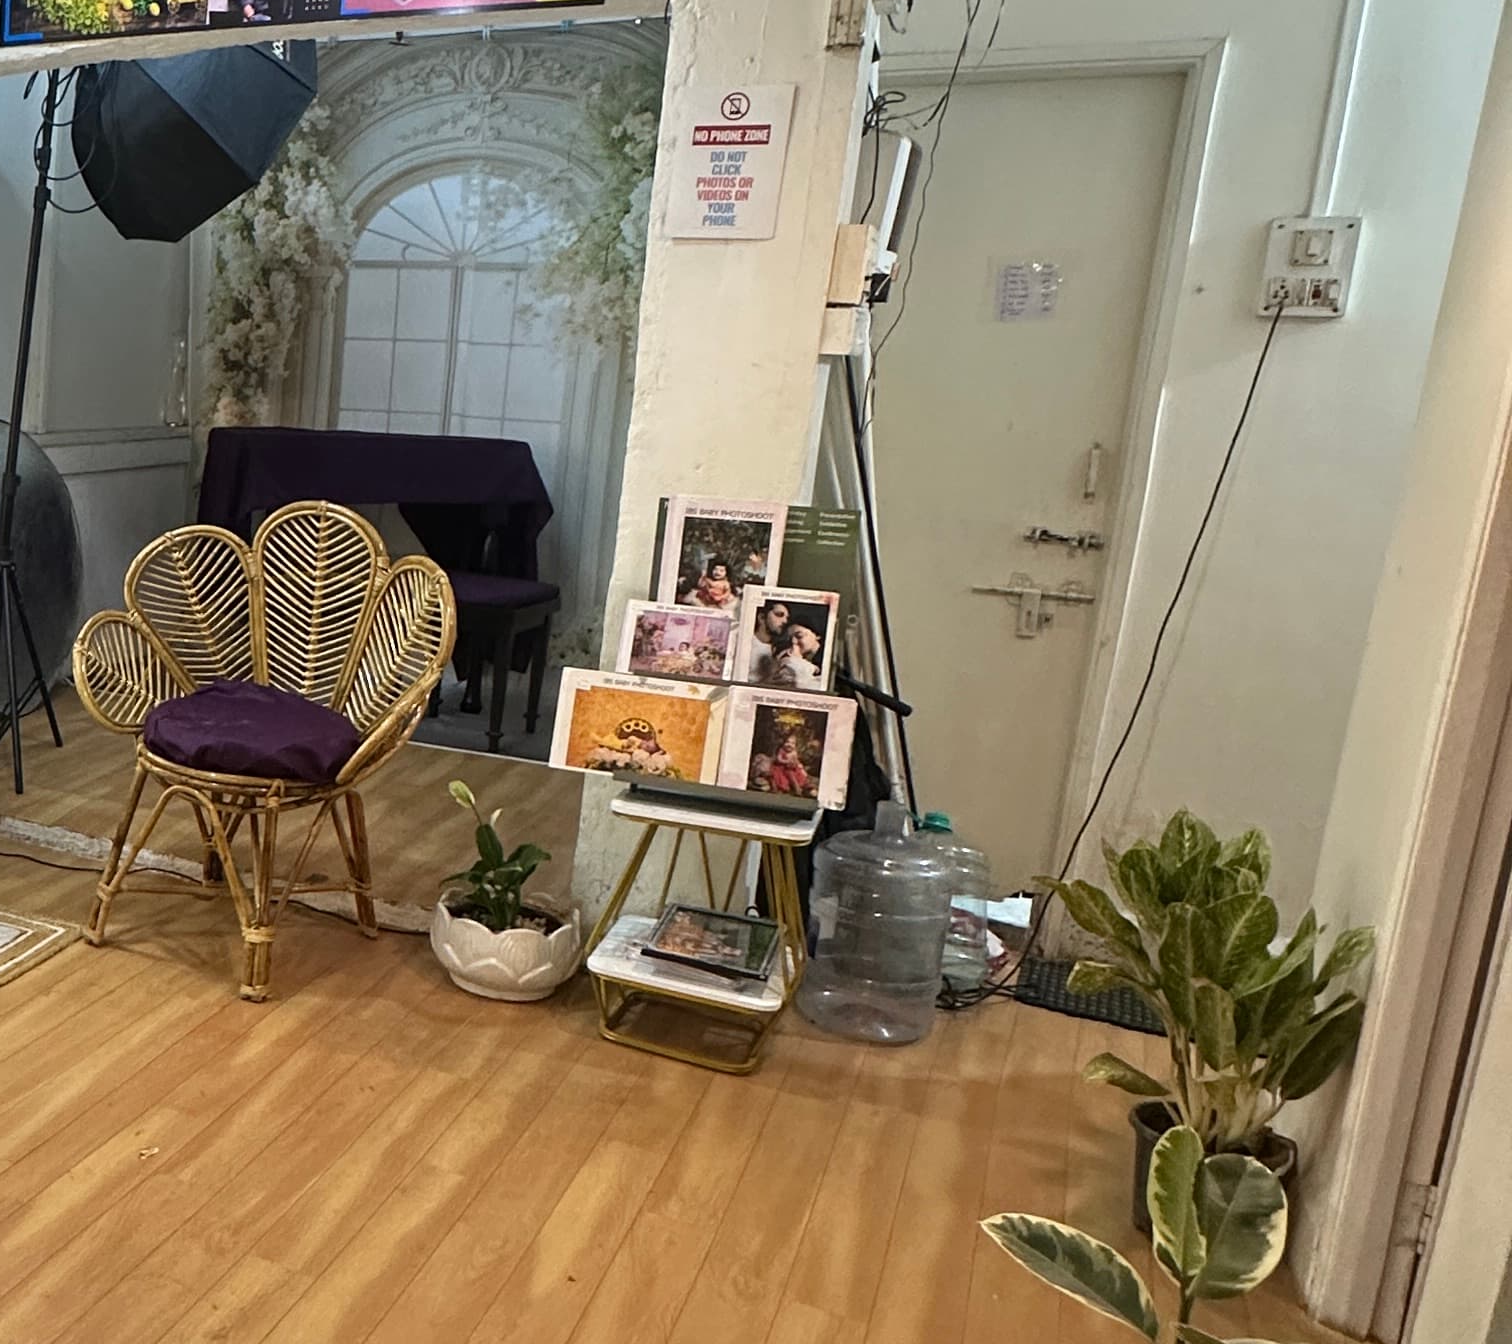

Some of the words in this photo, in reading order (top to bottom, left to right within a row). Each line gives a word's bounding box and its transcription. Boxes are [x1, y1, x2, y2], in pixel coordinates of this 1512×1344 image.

[695, 130, 708, 142] NO
[709, 129, 744, 142] PHONE
[744, 129, 768, 142] ZONE
[710, 151, 725, 162] DO
[727, 151, 747, 162] NOT
[712, 164, 741, 175] CLICK
[696, 177, 736, 188] PHOTOS
[738, 177, 754, 188] OR
[697, 190, 733, 201] VIDEOS
[734, 190, 749, 201] ON
[708, 202, 735, 213] YOUR
[702, 215, 736, 226] PHONE
